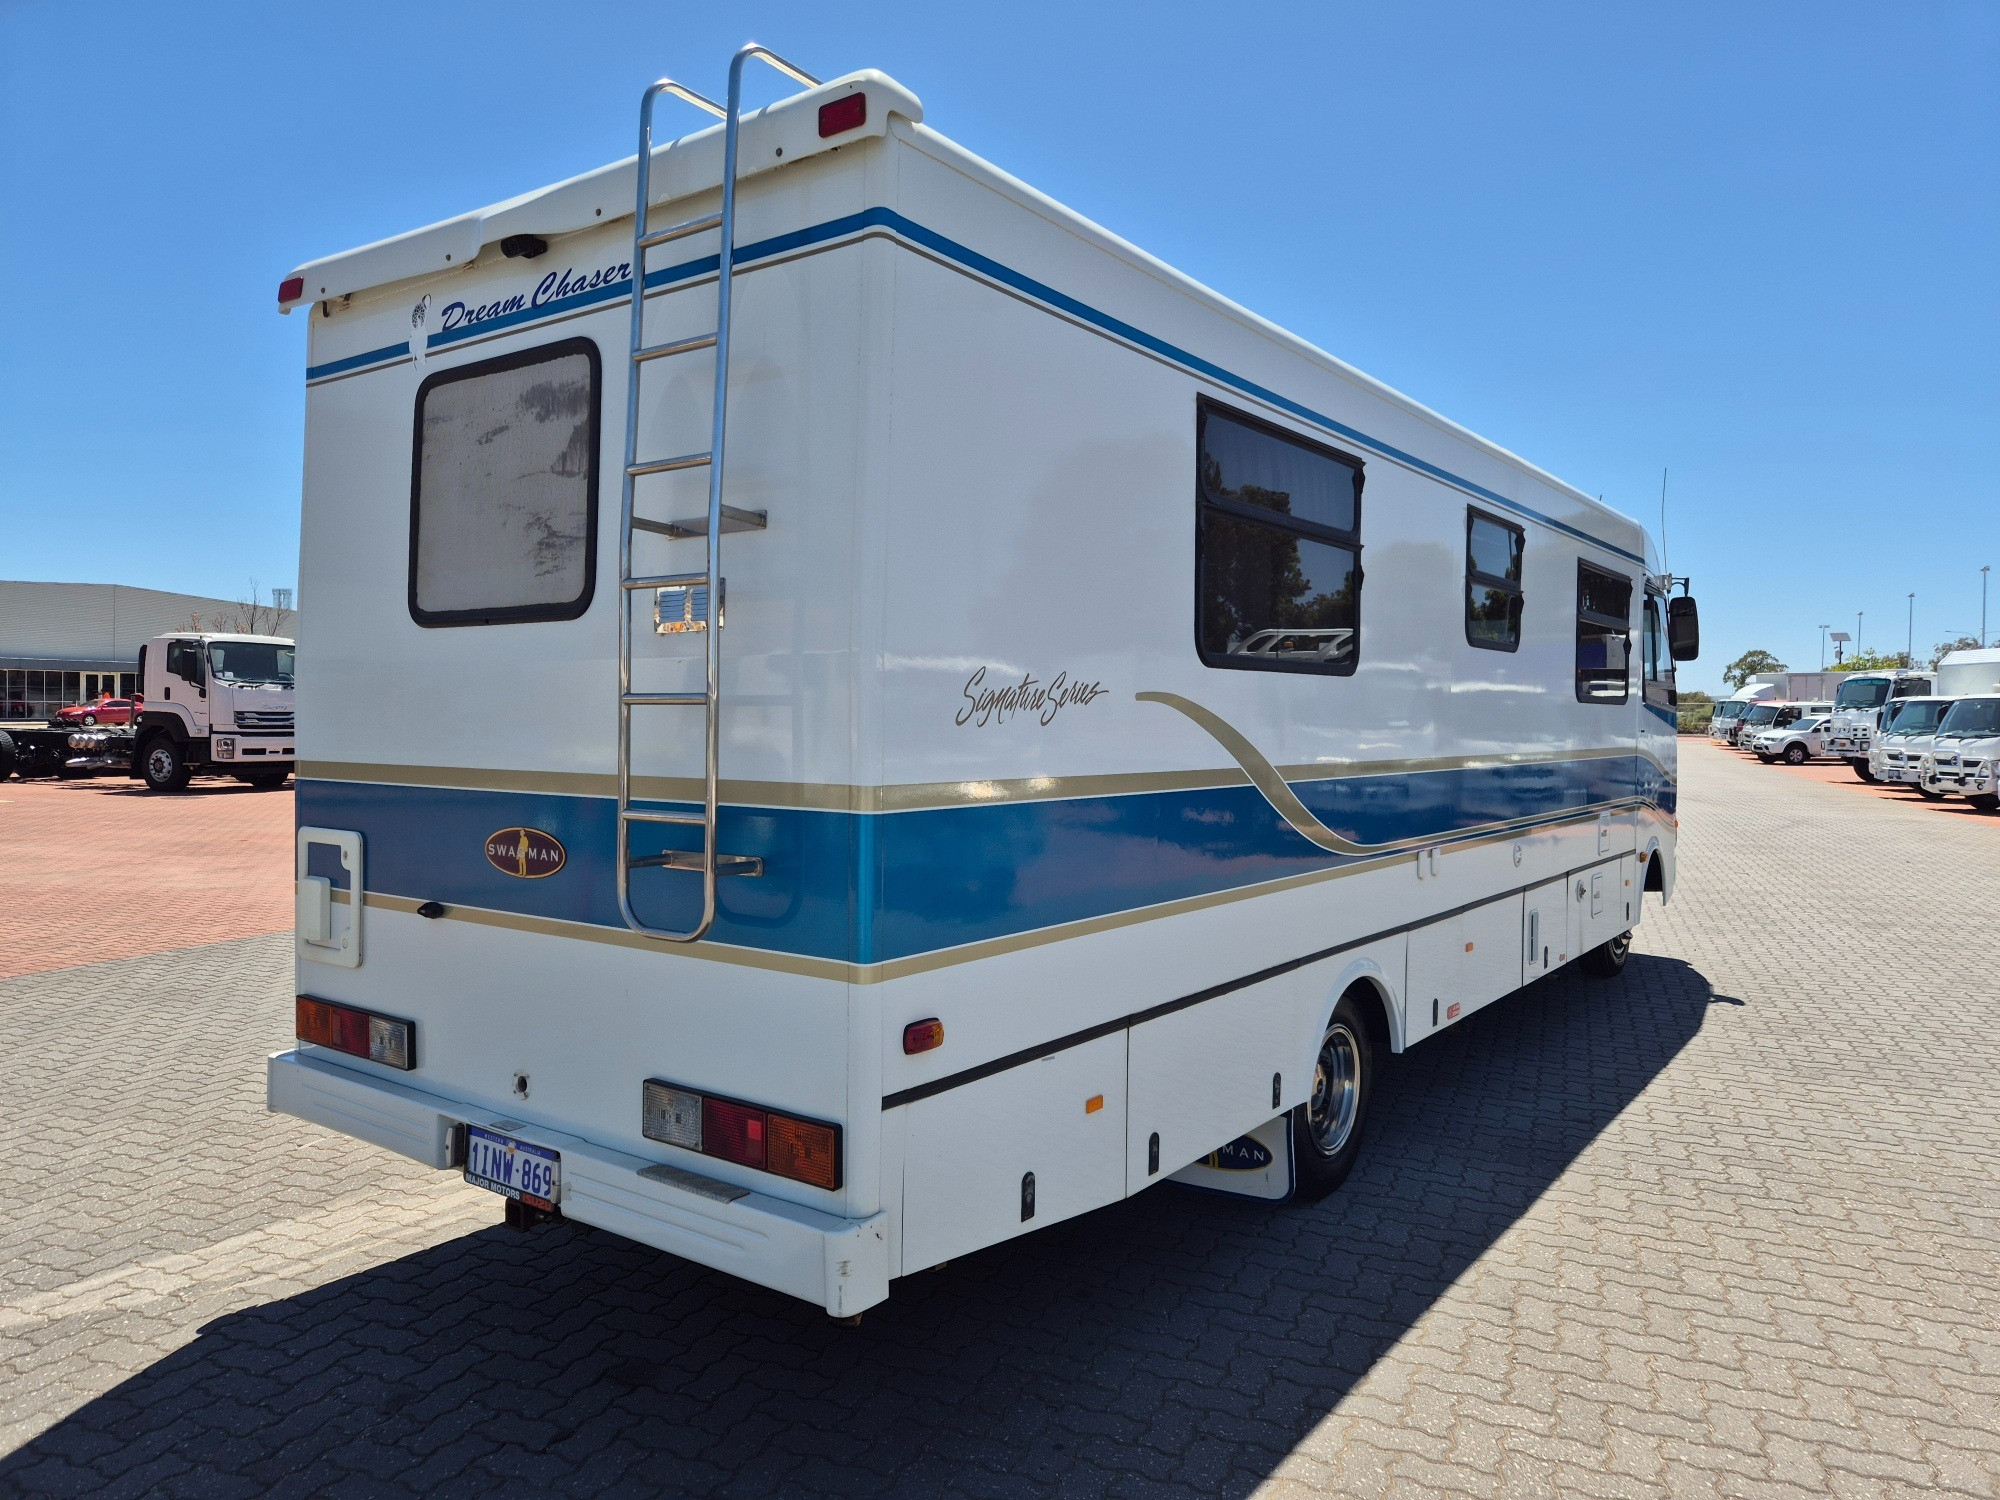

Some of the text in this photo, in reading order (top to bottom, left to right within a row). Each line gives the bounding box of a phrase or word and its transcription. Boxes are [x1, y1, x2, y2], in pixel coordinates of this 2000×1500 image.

[441, 262, 632, 332] Dream Chaser
[955, 666, 1109, 728] Signature Series
[484, 1133, 541, 1156] WESTERN AUSTRALIA
[465, 1173, 521, 1200] MAJOR MOTORS
